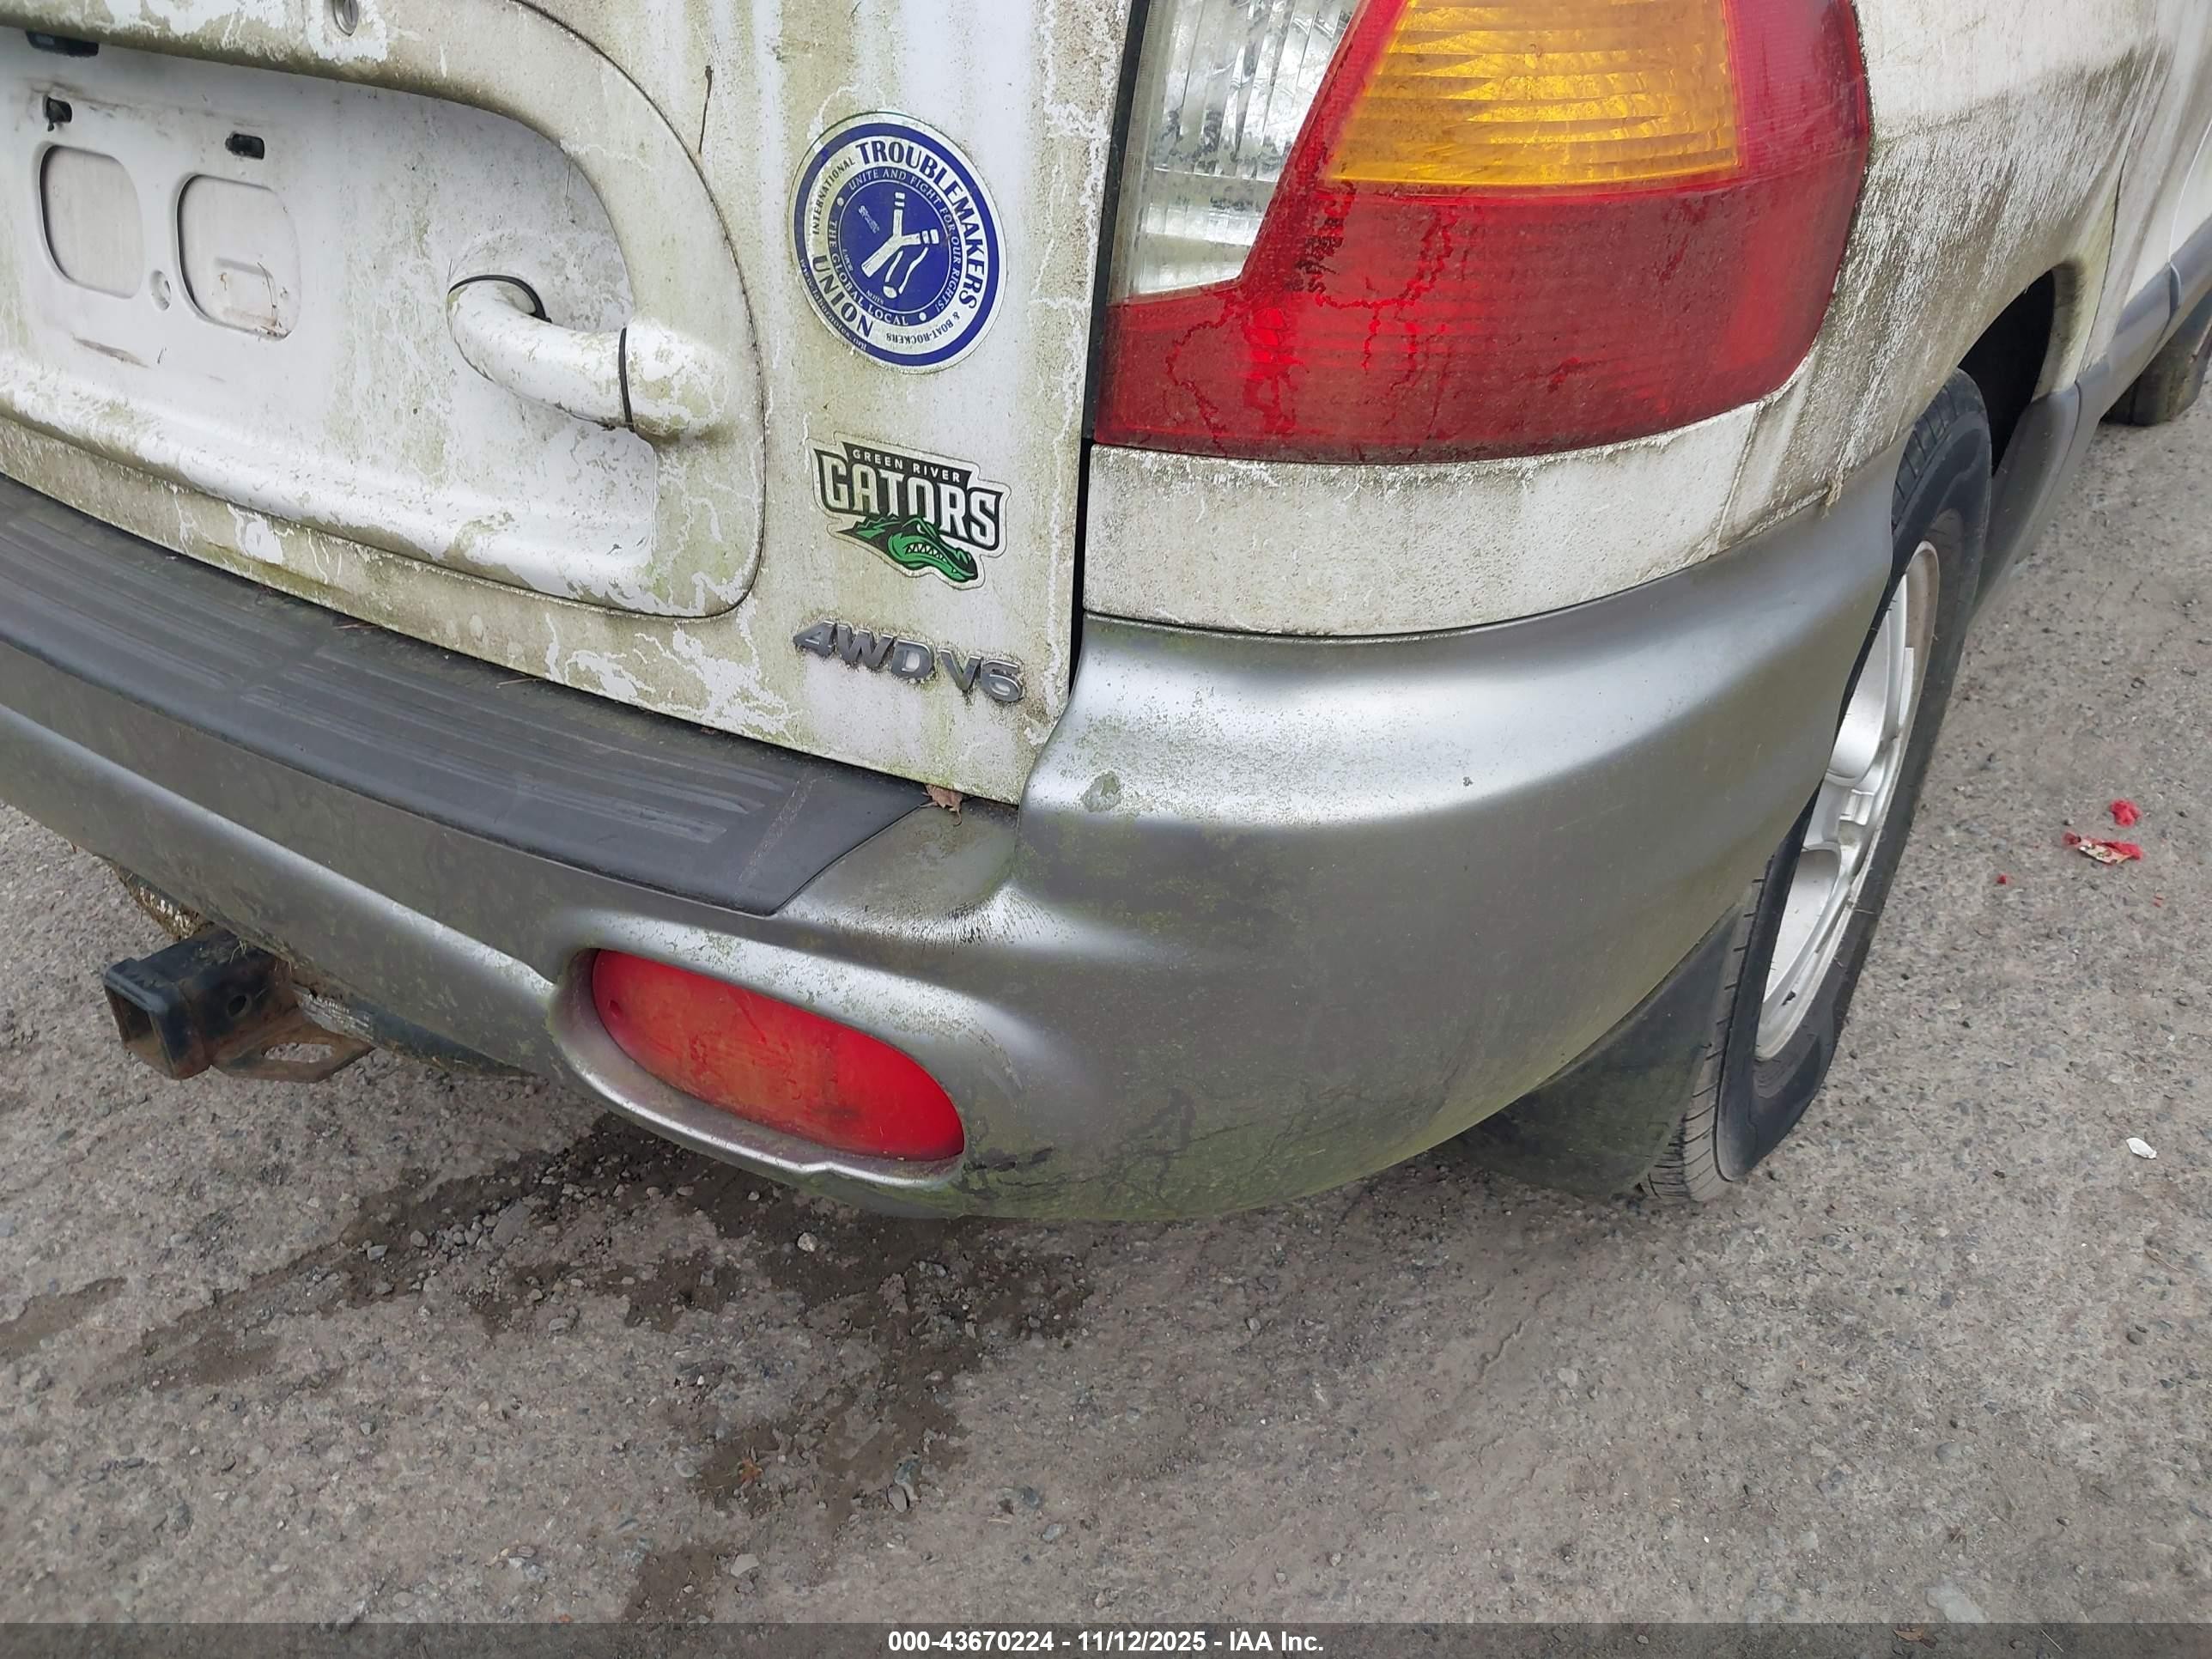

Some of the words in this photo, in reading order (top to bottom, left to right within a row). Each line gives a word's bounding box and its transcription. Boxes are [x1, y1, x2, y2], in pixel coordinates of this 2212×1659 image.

[848, 168, 880, 191] UNITE
[882, 168, 907, 181] AND
[909, 175, 941, 204] FIGHT
[812, 157, 855, 234] INTERNATIONAL
[828, 218, 838, 248] THE
[856, 140, 986, 309] TROUBLEMAKERS
[939, 206, 956, 233] FOR
[951, 235, 962, 264] OUR
[831, 252, 871, 307] GLOBAL
[935, 266, 961, 312] RIGHTS!
[812, 255, 873, 338] UNION
[866, 304, 909, 326] LOCAL
[885, 320, 953, 342] BOAT-ROCKERS
[852, 449, 904, 471] GREEN
[913, 462, 961, 483] RIVER
[820, 453, 1000, 548] GATORS
[793, 619, 935, 682] 4WD
[938, 647, 1024, 702] V6
